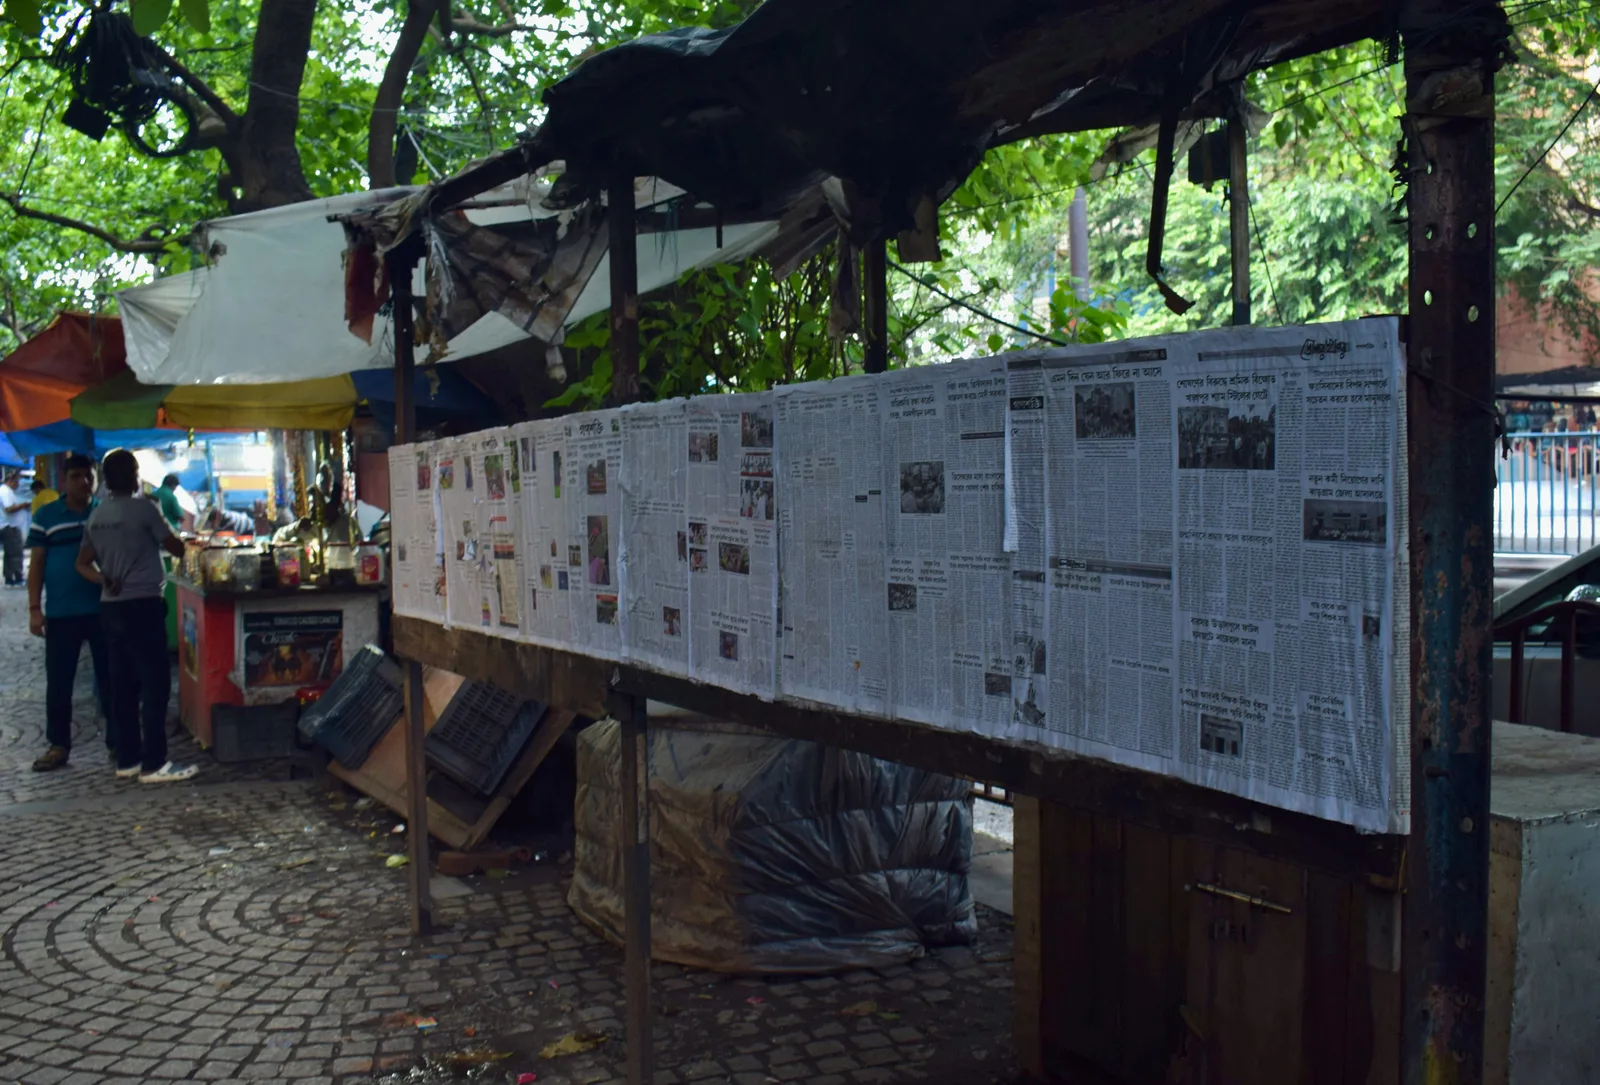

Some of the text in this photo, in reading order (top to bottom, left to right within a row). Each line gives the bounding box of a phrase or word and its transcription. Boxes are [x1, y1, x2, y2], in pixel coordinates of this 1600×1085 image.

[1096, 370, 1110, 380] আর
[1132, 368, 1140, 378] না
[1142, 366, 1162, 377] আসে
[1229, 373, 1249, 385] শ্রমিক
[1252, 372, 1276, 384] বিক্ষোভ
[1364, 378, 1389, 388] সম্পর্কে
[1330, 395, 1348, 403] করতে
[1350, 394, 1363, 403] হবে
[1364, 394, 1392, 404] মানুষকে
[1308, 472, 1385, 485] নতুন কর্মী নিয়োগের দাবি
[1335, 488, 1352, 498] জেলা
[1354, 490, 1384, 499] আদালতে
